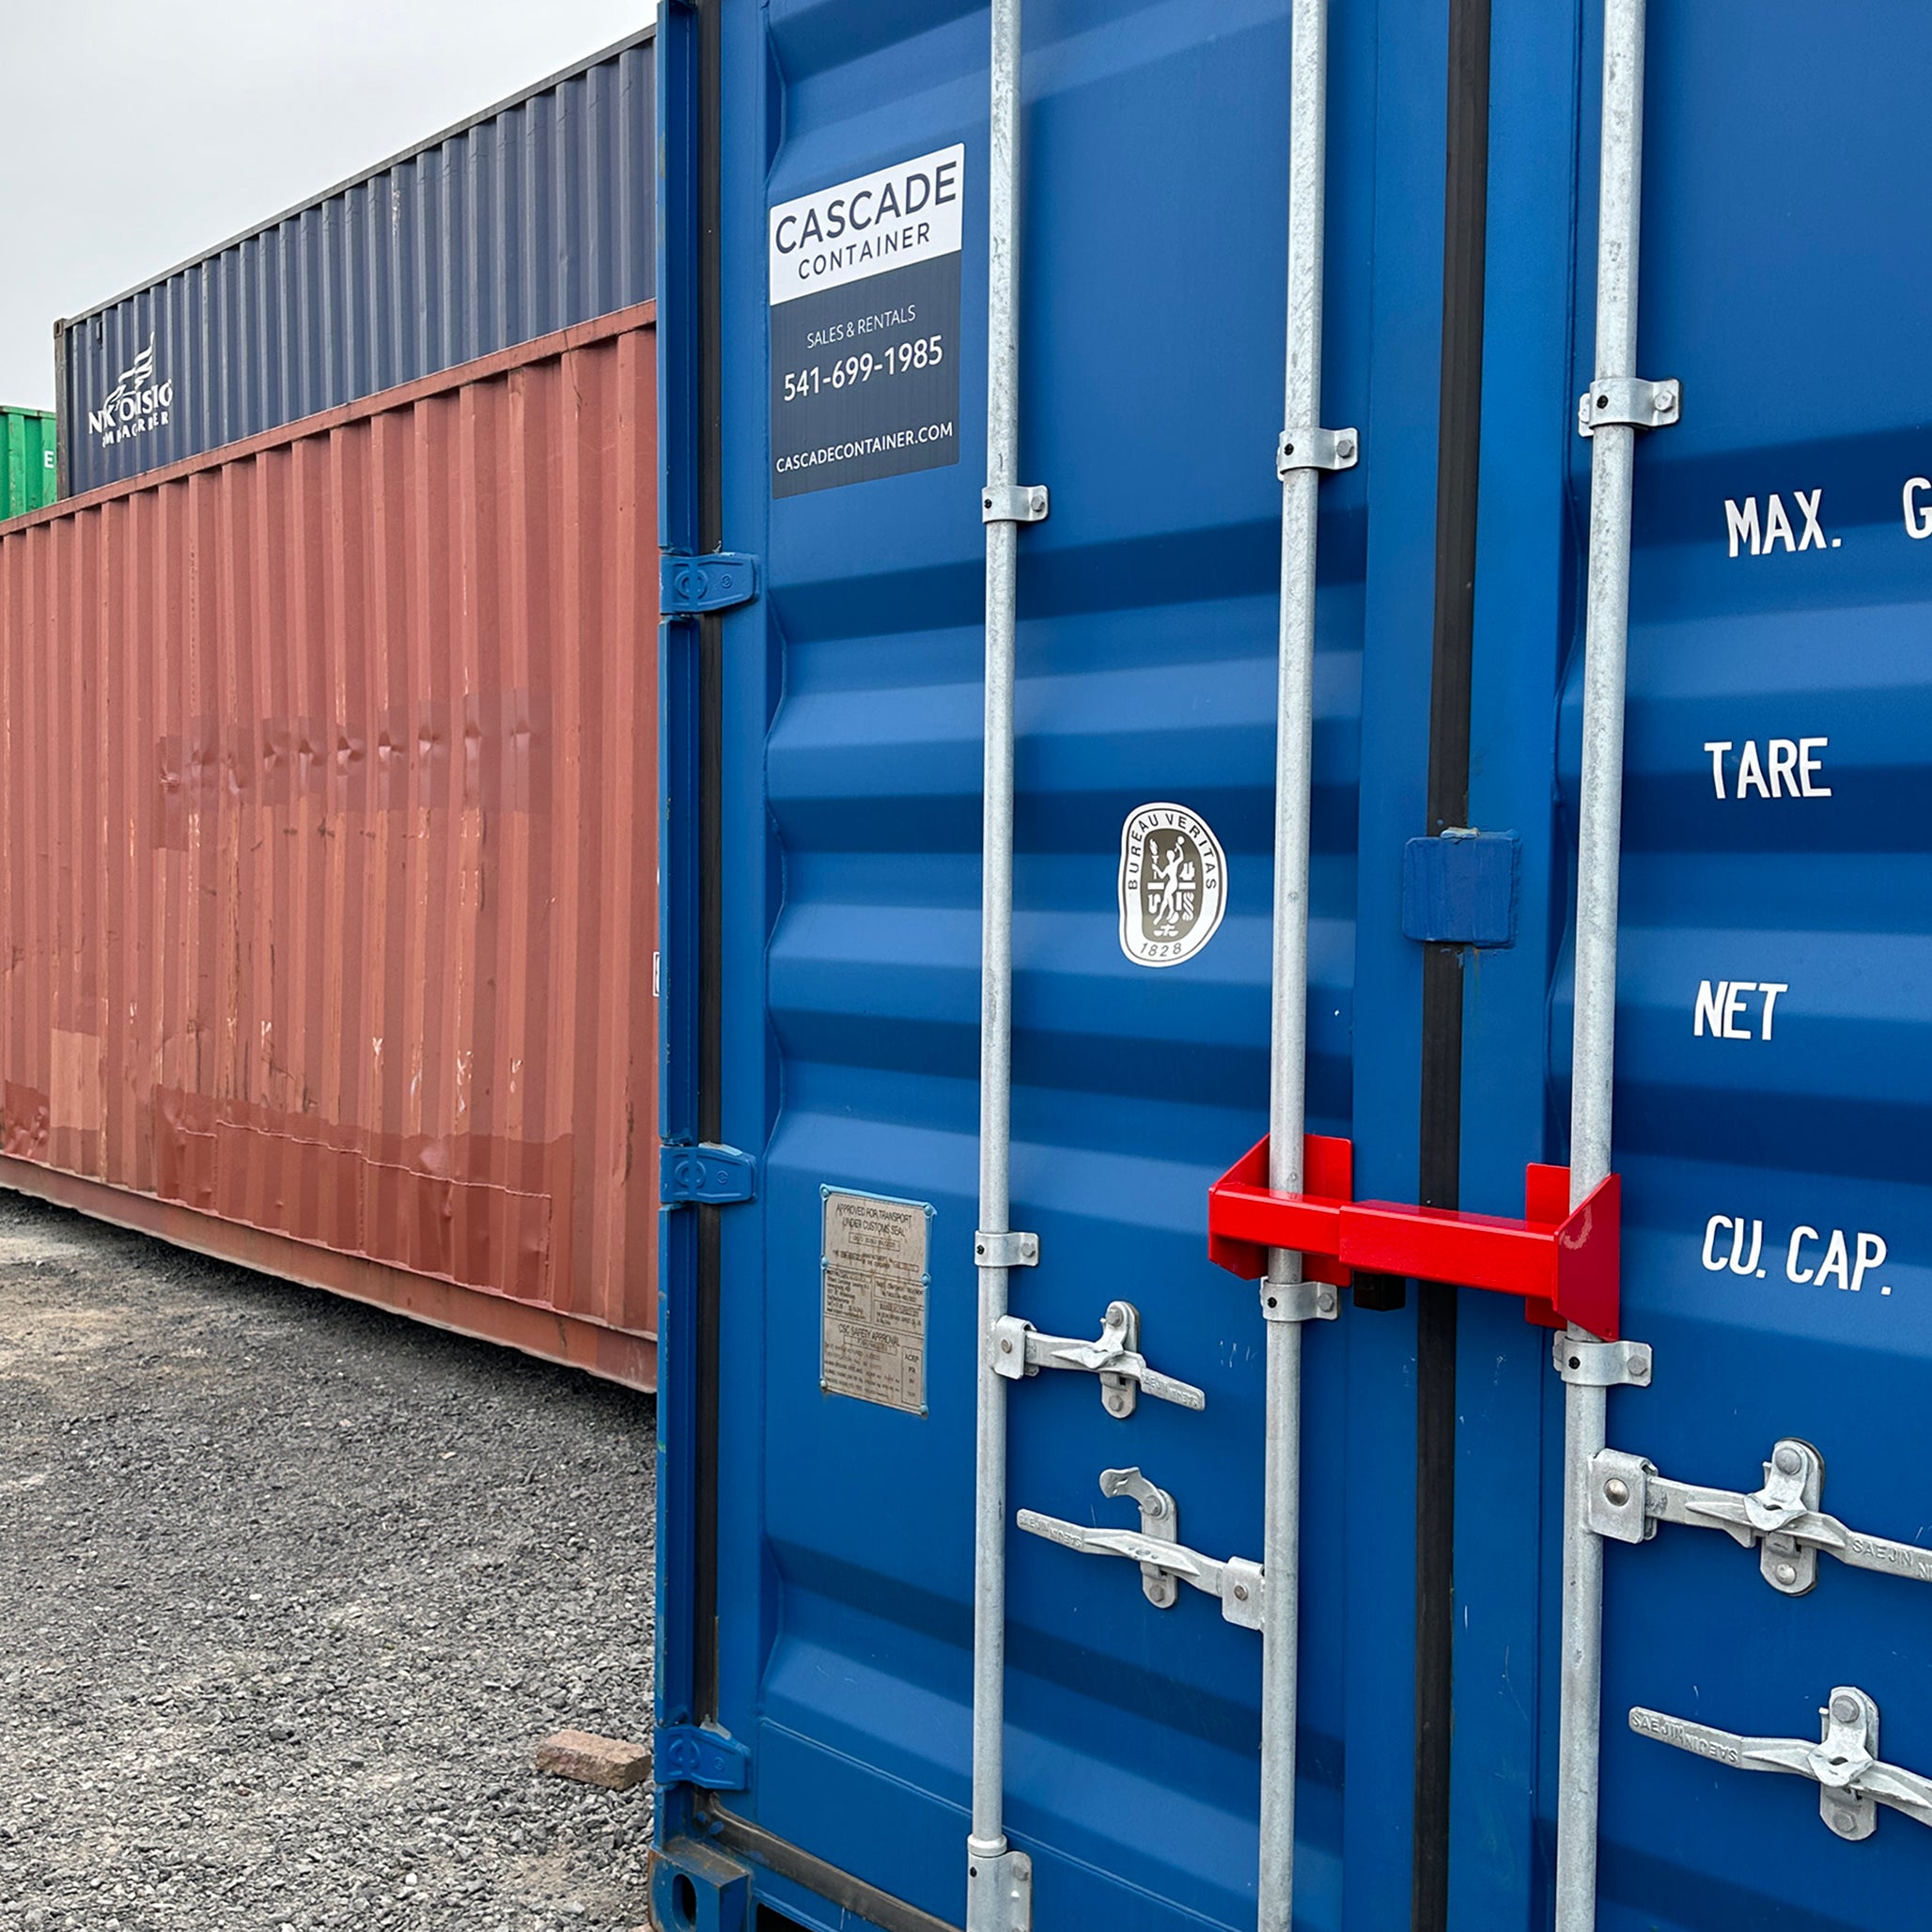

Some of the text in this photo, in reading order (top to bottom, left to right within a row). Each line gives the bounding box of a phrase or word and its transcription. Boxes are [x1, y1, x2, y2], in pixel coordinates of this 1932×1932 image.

[775, 160, 958, 255] CASCADE
[798, 222, 930, 280] CONTAINER
[806, 304, 917, 350] SALES & RENTALS
[783, 335, 943, 402] 541-699-1985
[43, 450, 55, 469] E
[775, 421, 954, 474] CASCADECONTAINER.COM
[1724, 488, 1843, 558] MAX.
[1704, 737, 1832, 800] TARE
[1128, 812, 1218, 890] BUREAU VERITAS
[1140, 942, 1182, 958] 1828
[1693, 979, 1789, 1041] NET
[866, 1208, 879, 1220] FOR
[879, 1209, 912, 1223] TRANSPORT
[1701, 1214, 1893, 1296] CU. CAP.
[1852, 1539, 1913, 1566] SAEJIN
